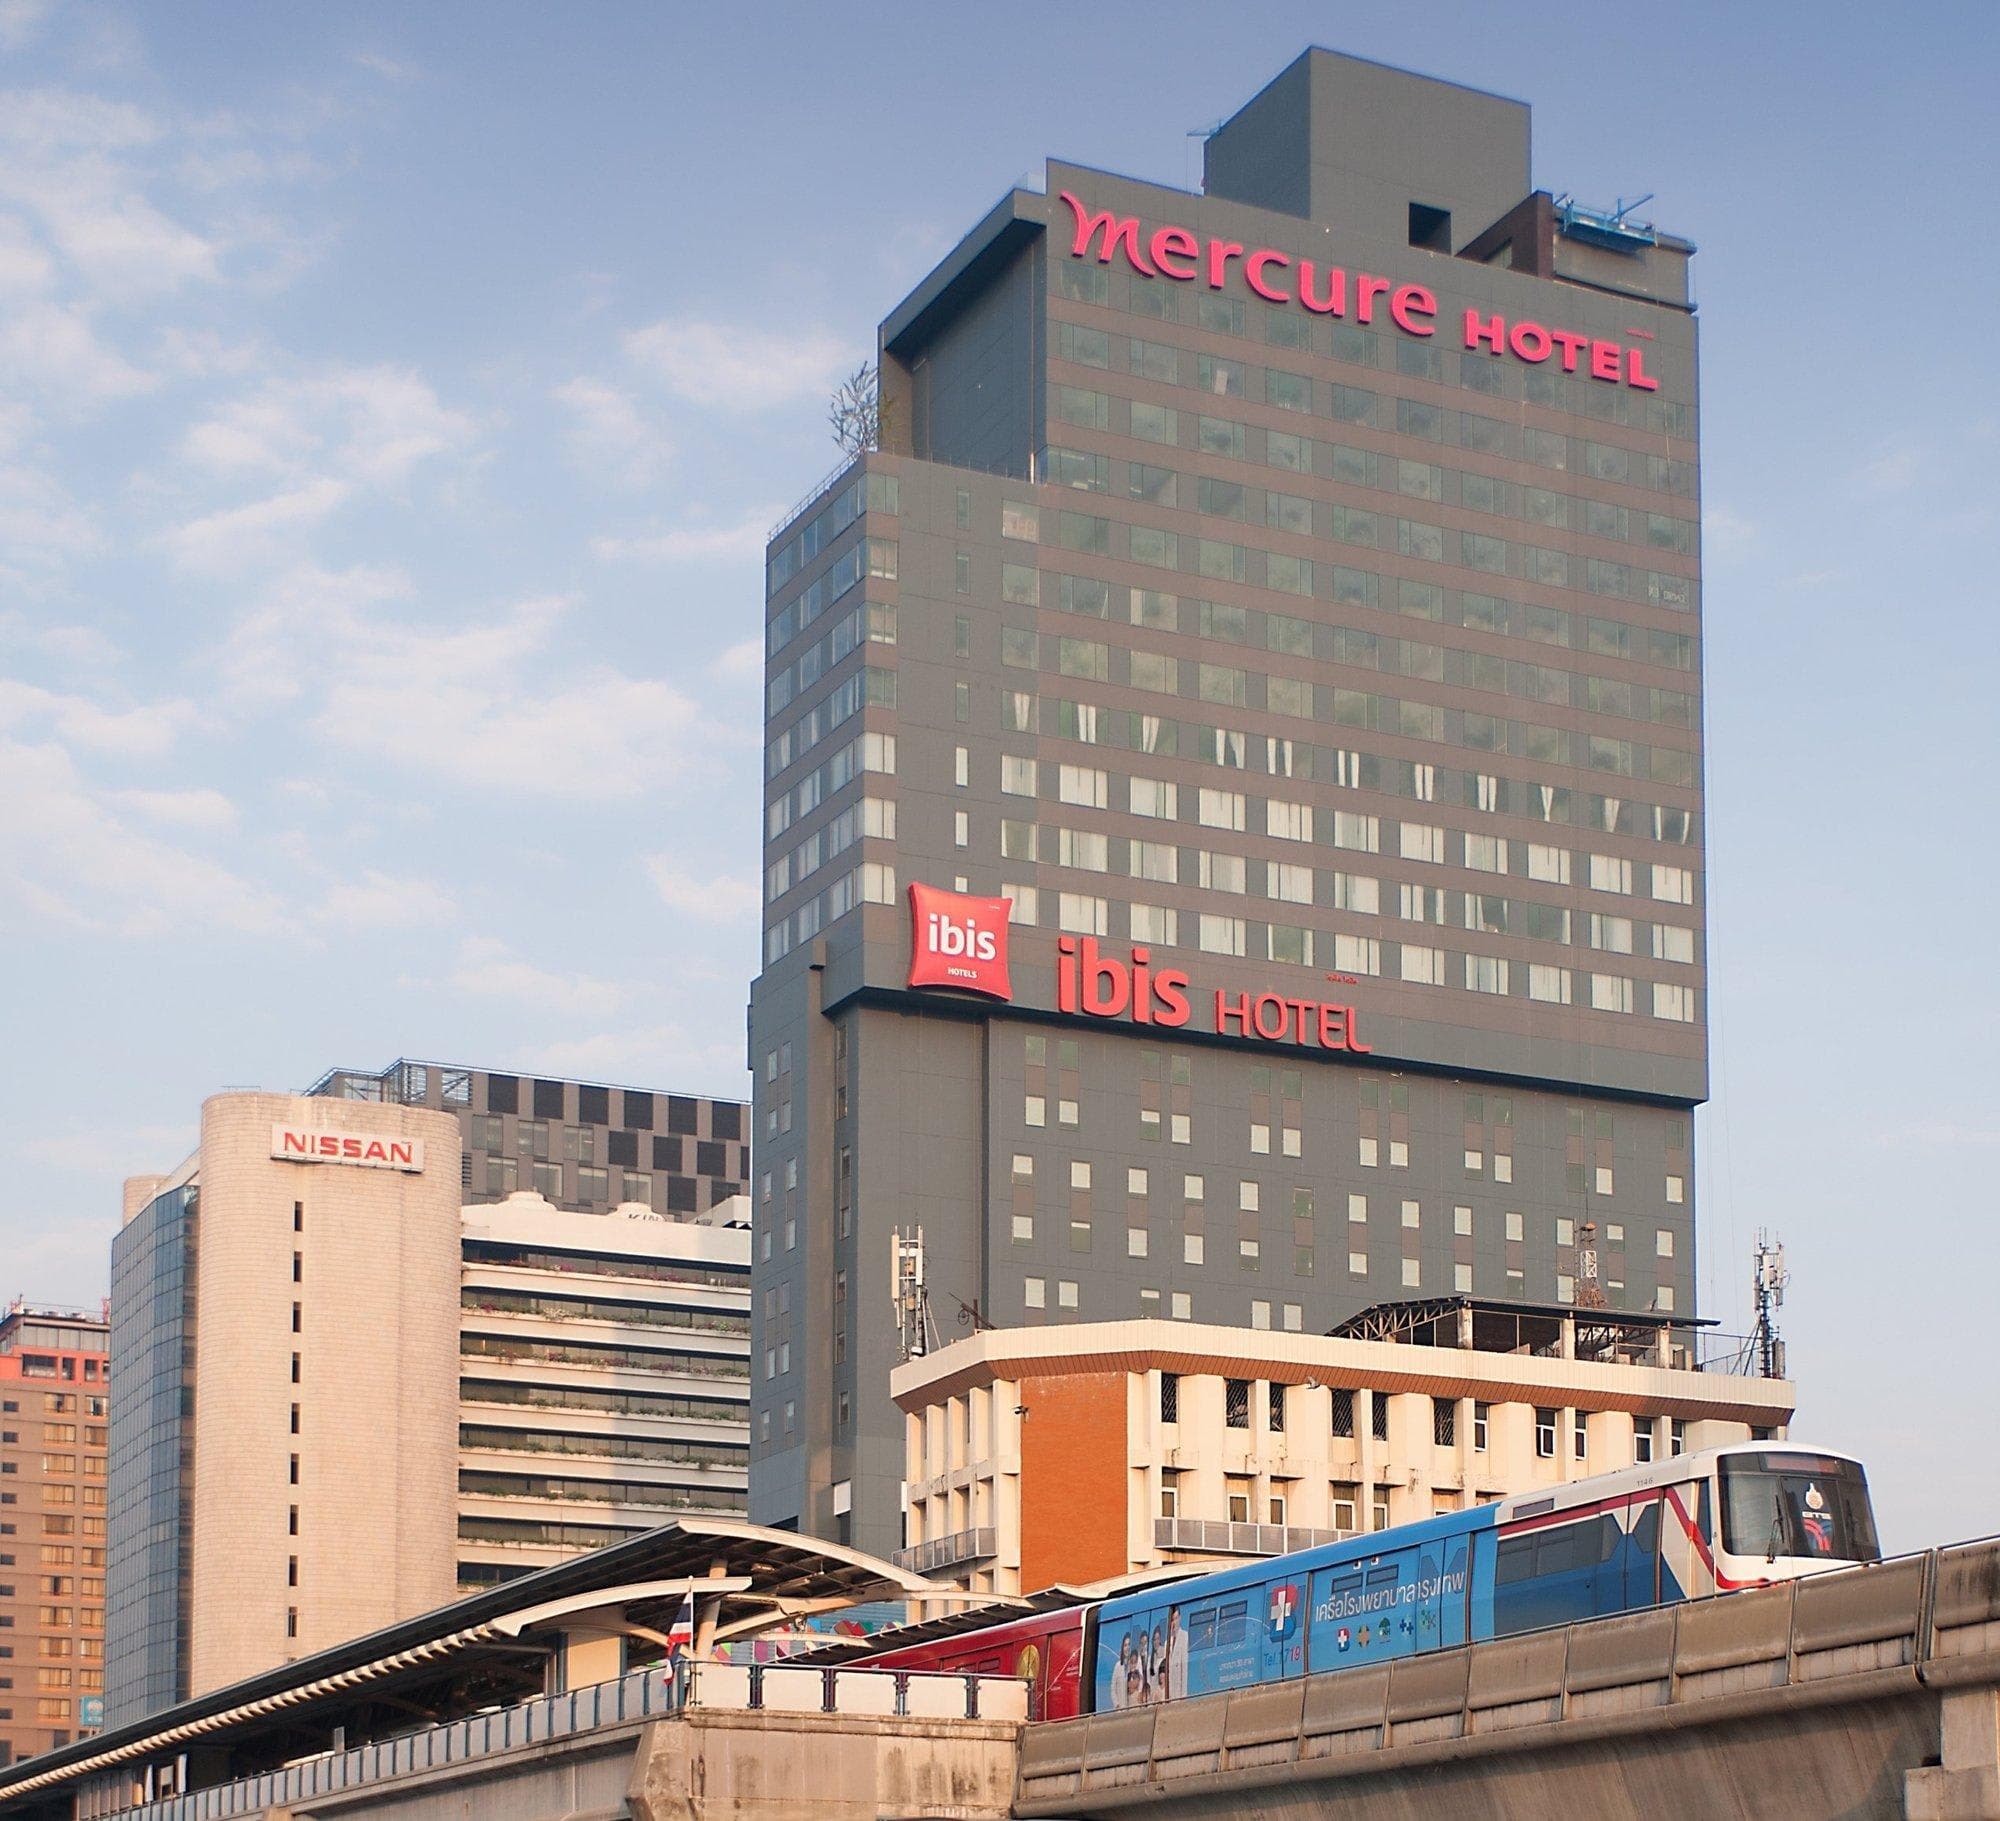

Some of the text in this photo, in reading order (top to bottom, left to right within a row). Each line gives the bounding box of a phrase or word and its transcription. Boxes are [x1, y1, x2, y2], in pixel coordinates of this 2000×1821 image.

[1463, 307, 1659, 390] HOTEL
[929, 912, 996, 960] ibis
[947, 967, 978, 979] HOTELS
[1056, 934, 1373, 1053] ibis HOTEL
[284, 1132, 412, 1164] NISSAN
